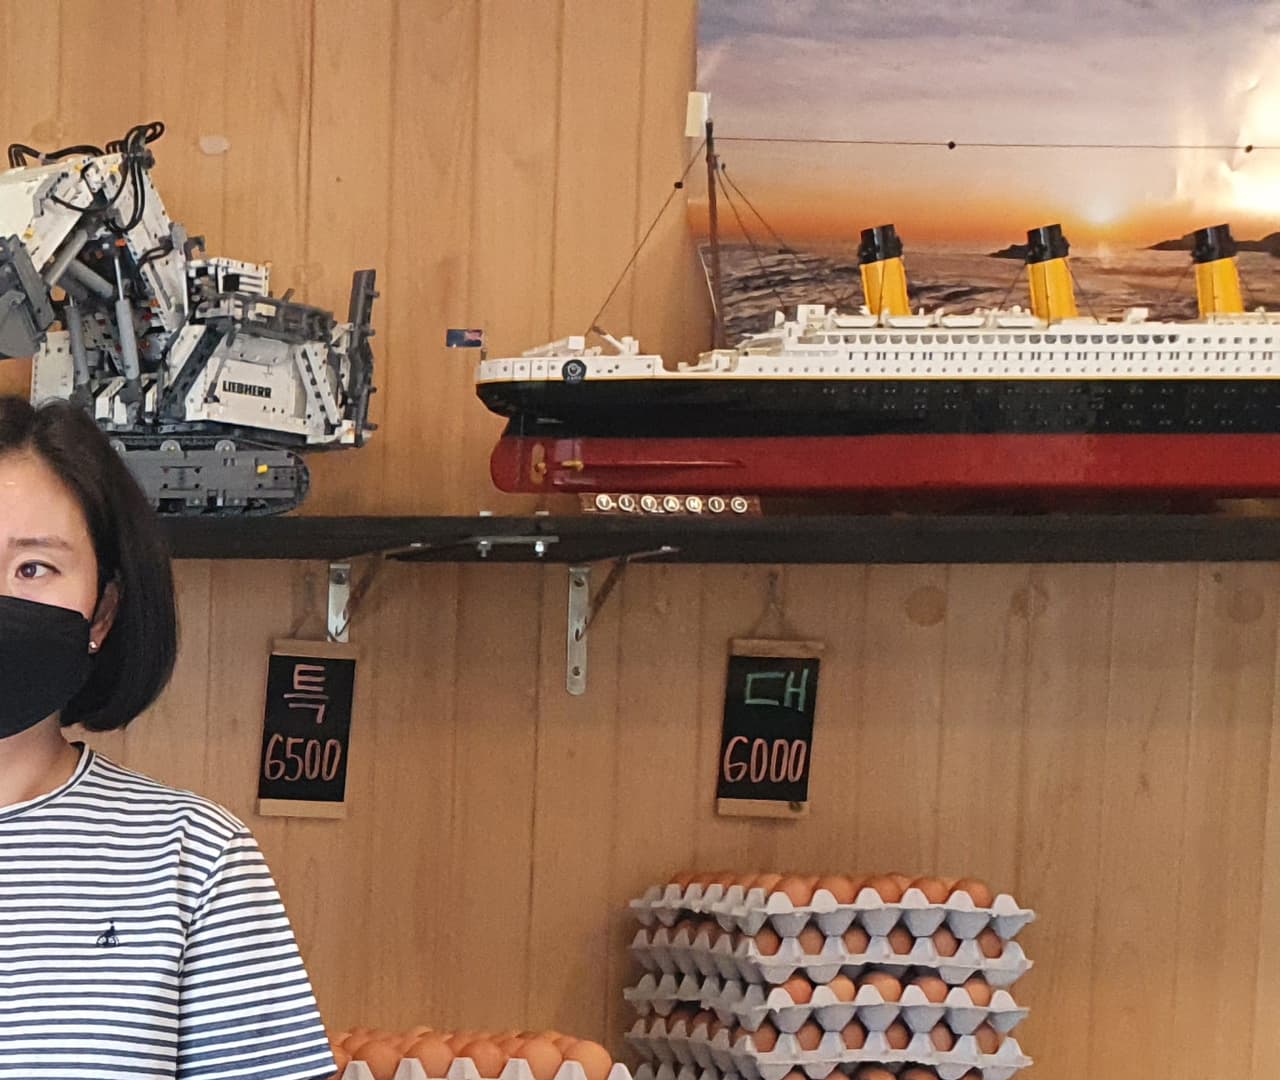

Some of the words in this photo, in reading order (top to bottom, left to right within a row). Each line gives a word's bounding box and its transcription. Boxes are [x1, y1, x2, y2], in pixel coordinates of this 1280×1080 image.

[222, 380, 272, 399] LIEBHERR
[596, 494, 748, 514] TITANIC
[283, 663, 329, 725] 특
[744, 667, 809, 713] 대
[263, 733, 342, 782] 6500
[723, 735, 808, 783] 6000
